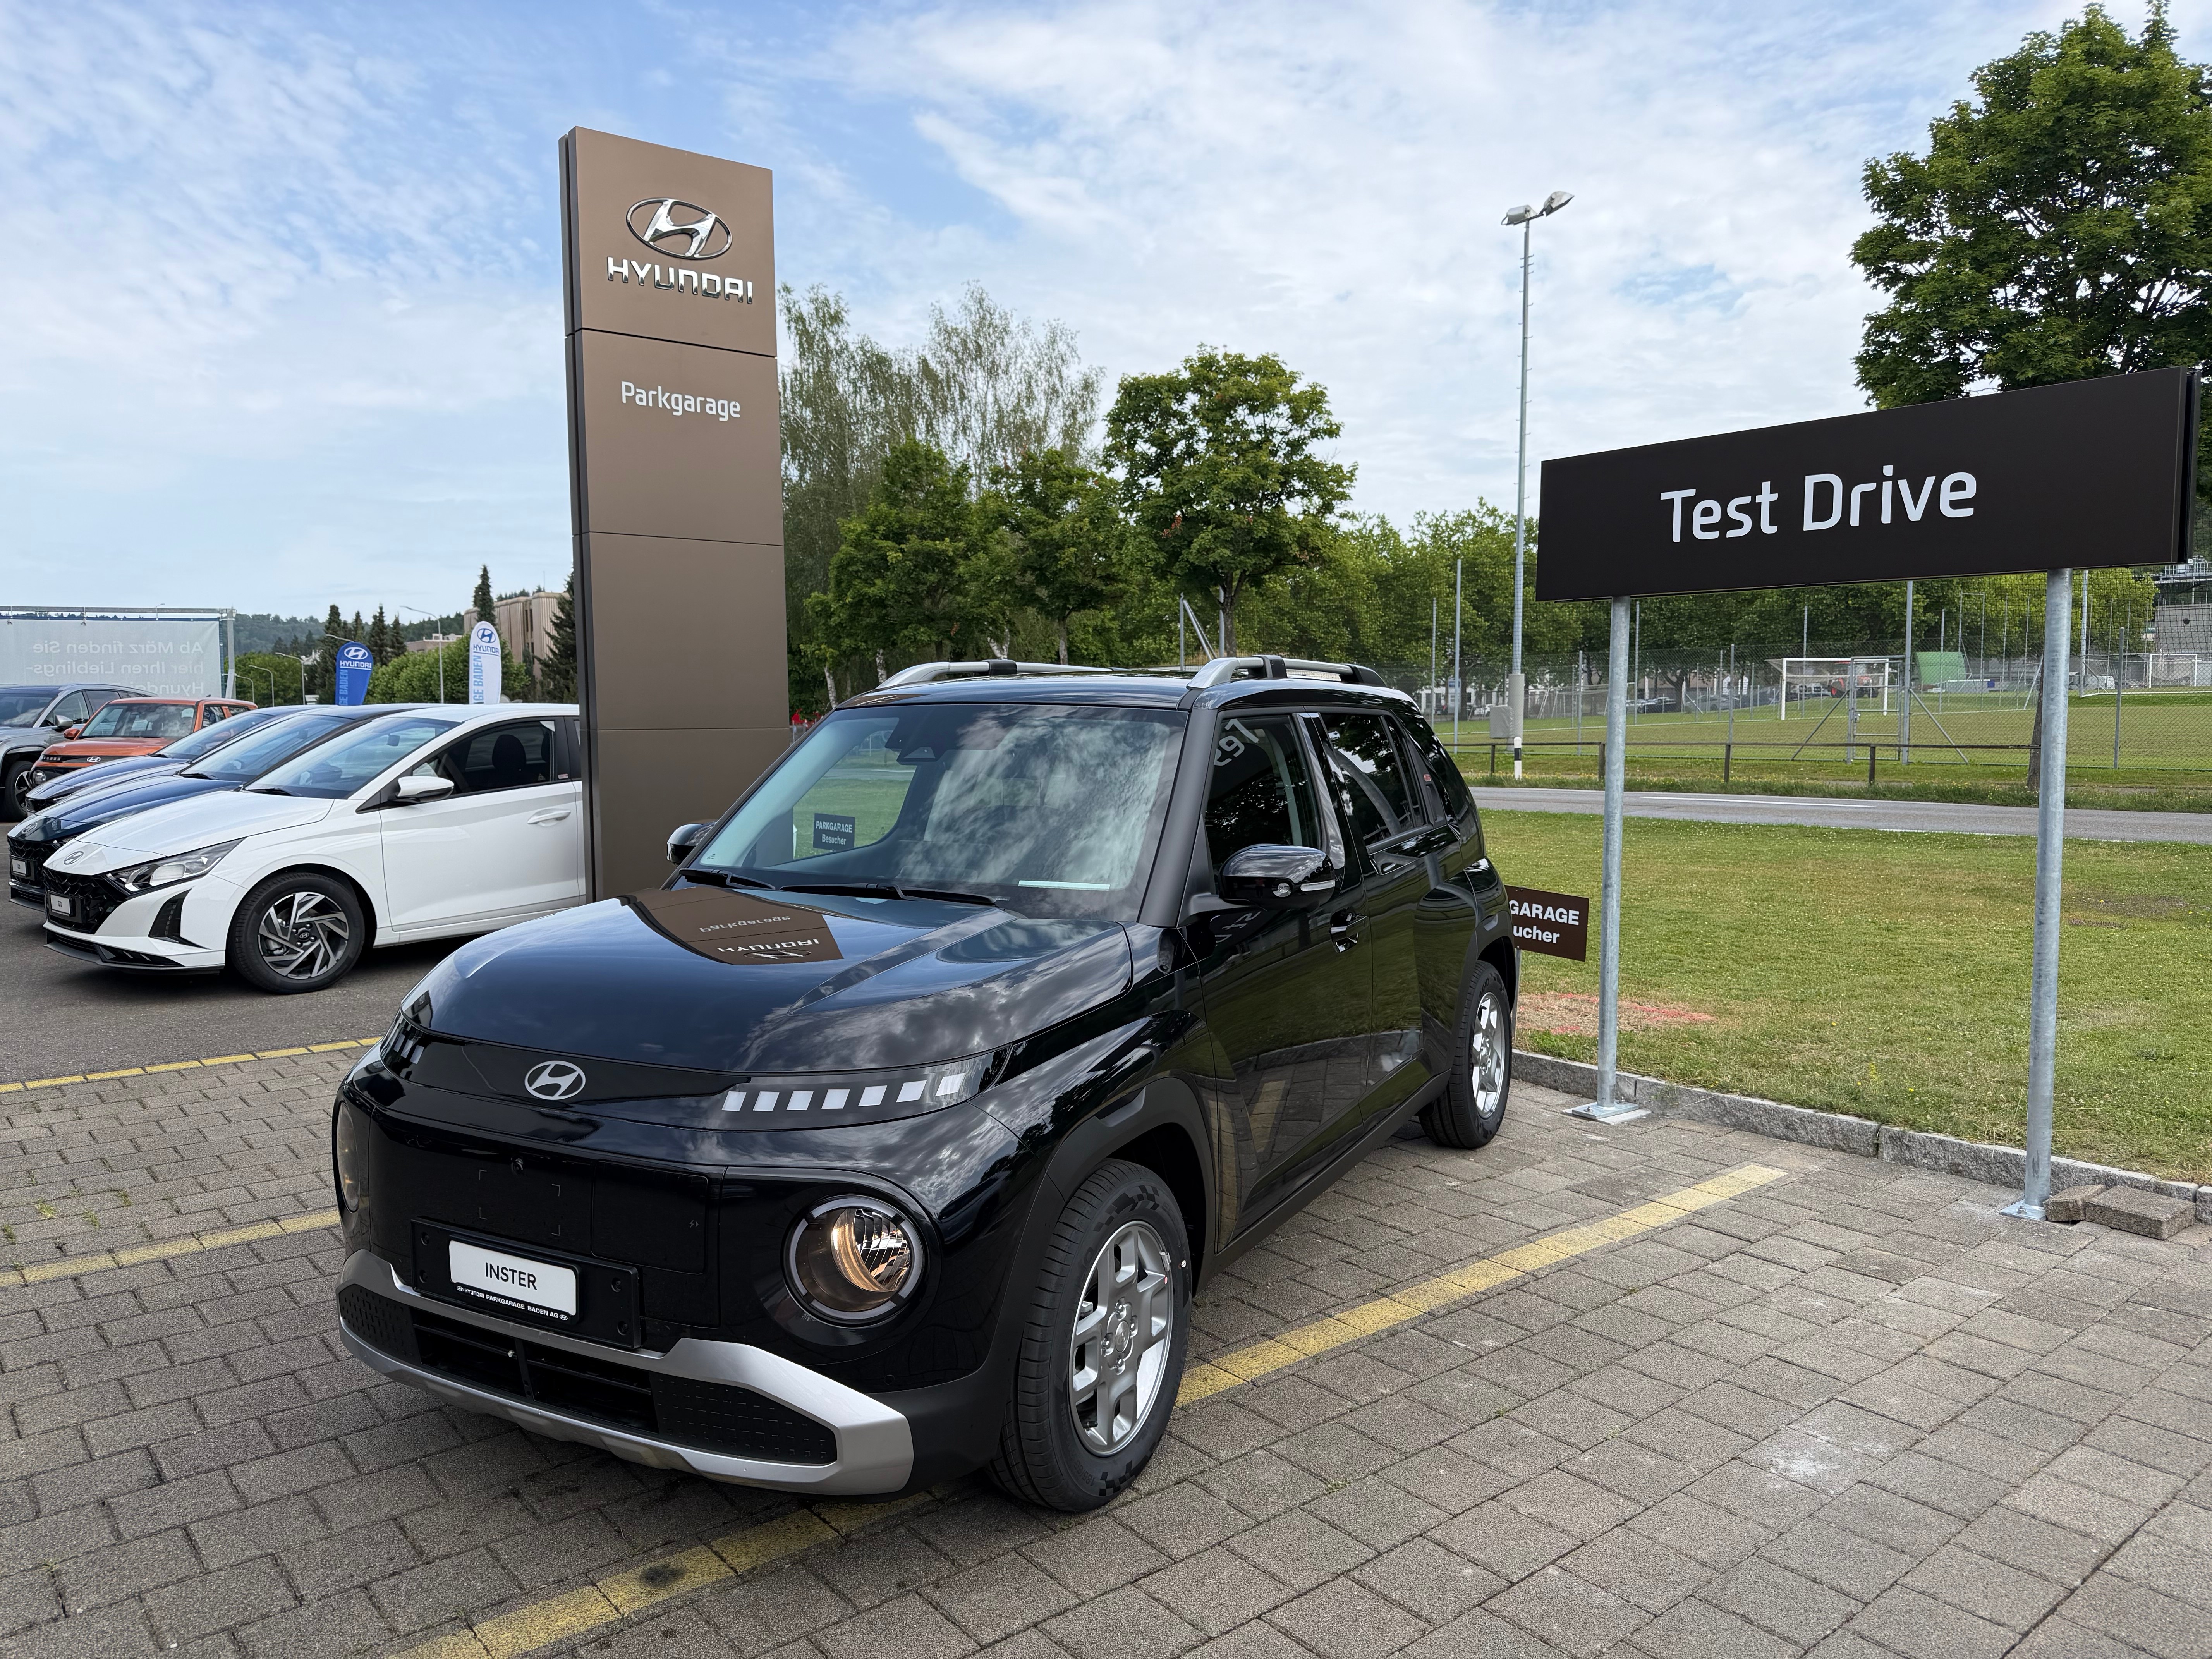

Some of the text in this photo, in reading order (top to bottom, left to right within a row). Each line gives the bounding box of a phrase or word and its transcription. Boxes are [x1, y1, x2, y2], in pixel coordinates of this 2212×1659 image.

[607, 257, 753, 304] HYUNDAI
[622, 381, 741, 422] Parkgarage
[1660, 465, 1977, 543] Test Drive
[473, 644, 500, 654] HYUNDA
[339, 670, 348, 695] BADEN
[473, 656, 484, 687] BADEN
[816, 821, 853, 833] PARKGARAGE
[822, 834, 847, 845] Besucher
[1509, 900, 1580, 926] GARAGE
[1513, 926, 1560, 944] ucher
[485, 1262, 537, 1290] INSTER
[464, 1288, 484, 1298] HYUNDAI
[486, 1294, 525, 1310] PARKGARAGE
[527, 1305, 548, 1316] BADEN
